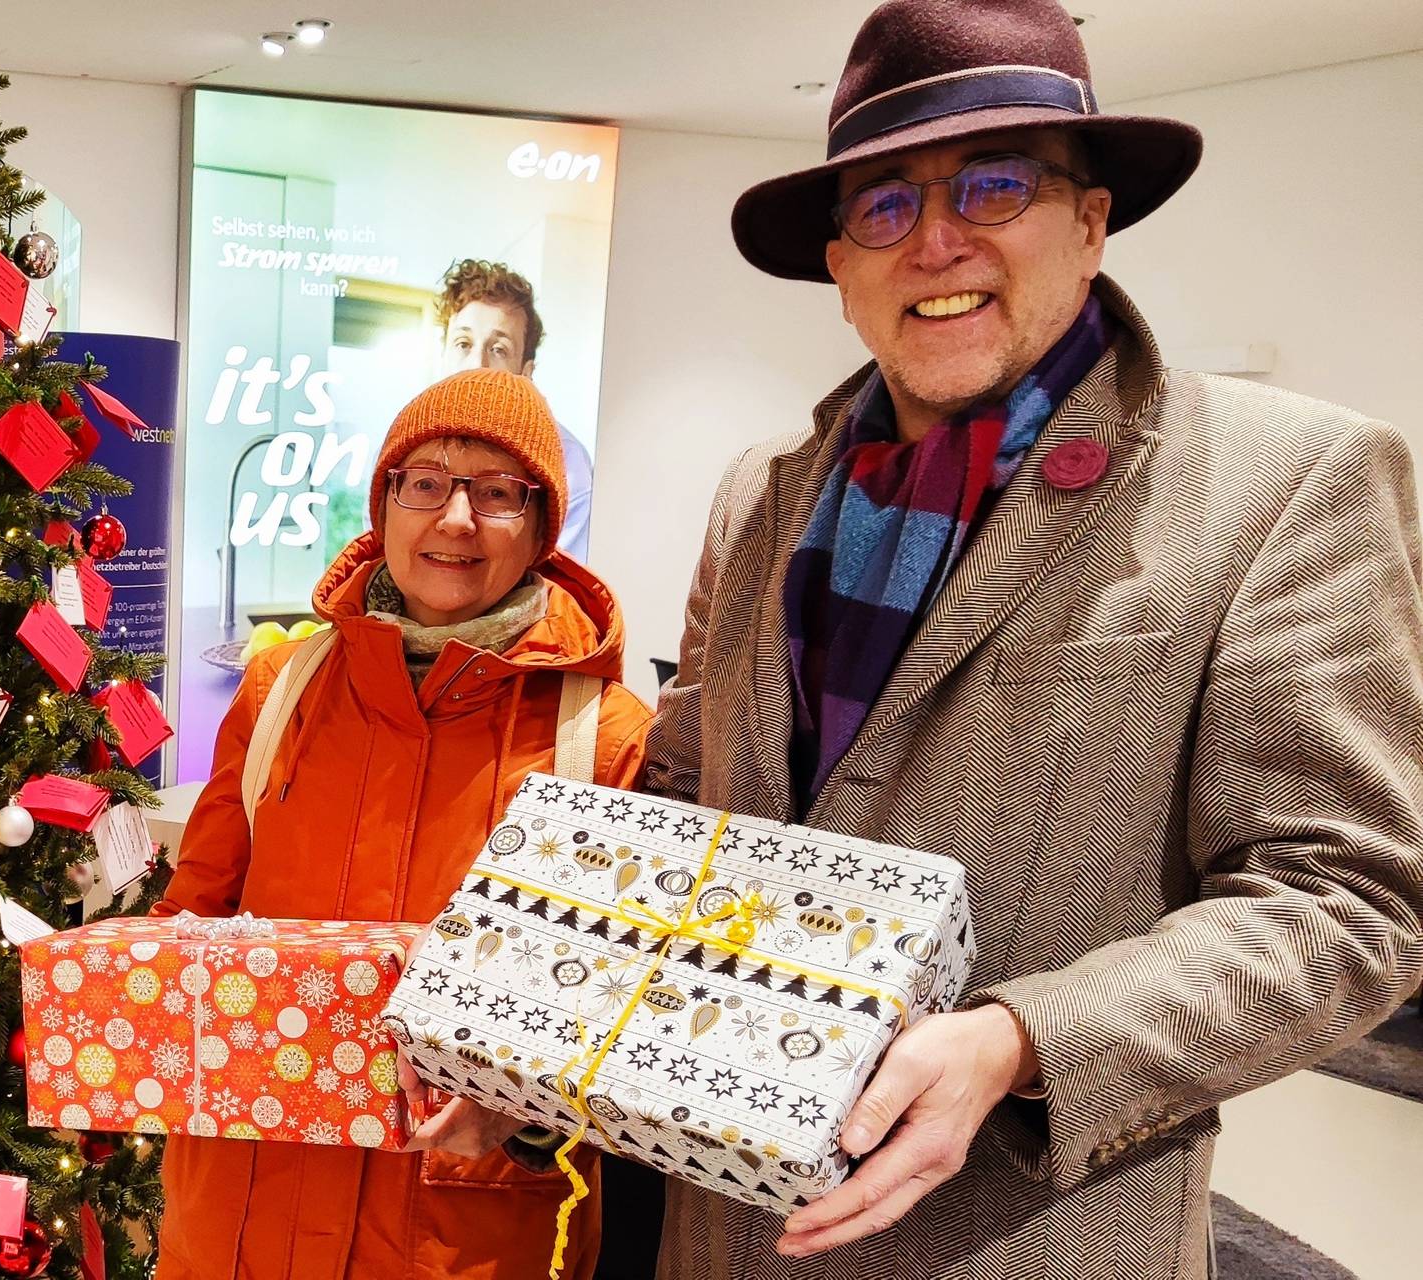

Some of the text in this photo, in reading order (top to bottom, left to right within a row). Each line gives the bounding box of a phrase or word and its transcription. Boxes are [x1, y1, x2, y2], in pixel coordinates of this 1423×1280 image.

[211, 216, 376, 243] Selbst sehen, wo ich
[218, 242, 400, 276] Strom sparen
[300, 277, 349, 297] kann?
[261, 431, 370, 487] on
[229, 491, 329, 546] us
[137, 547, 148, 557] der
